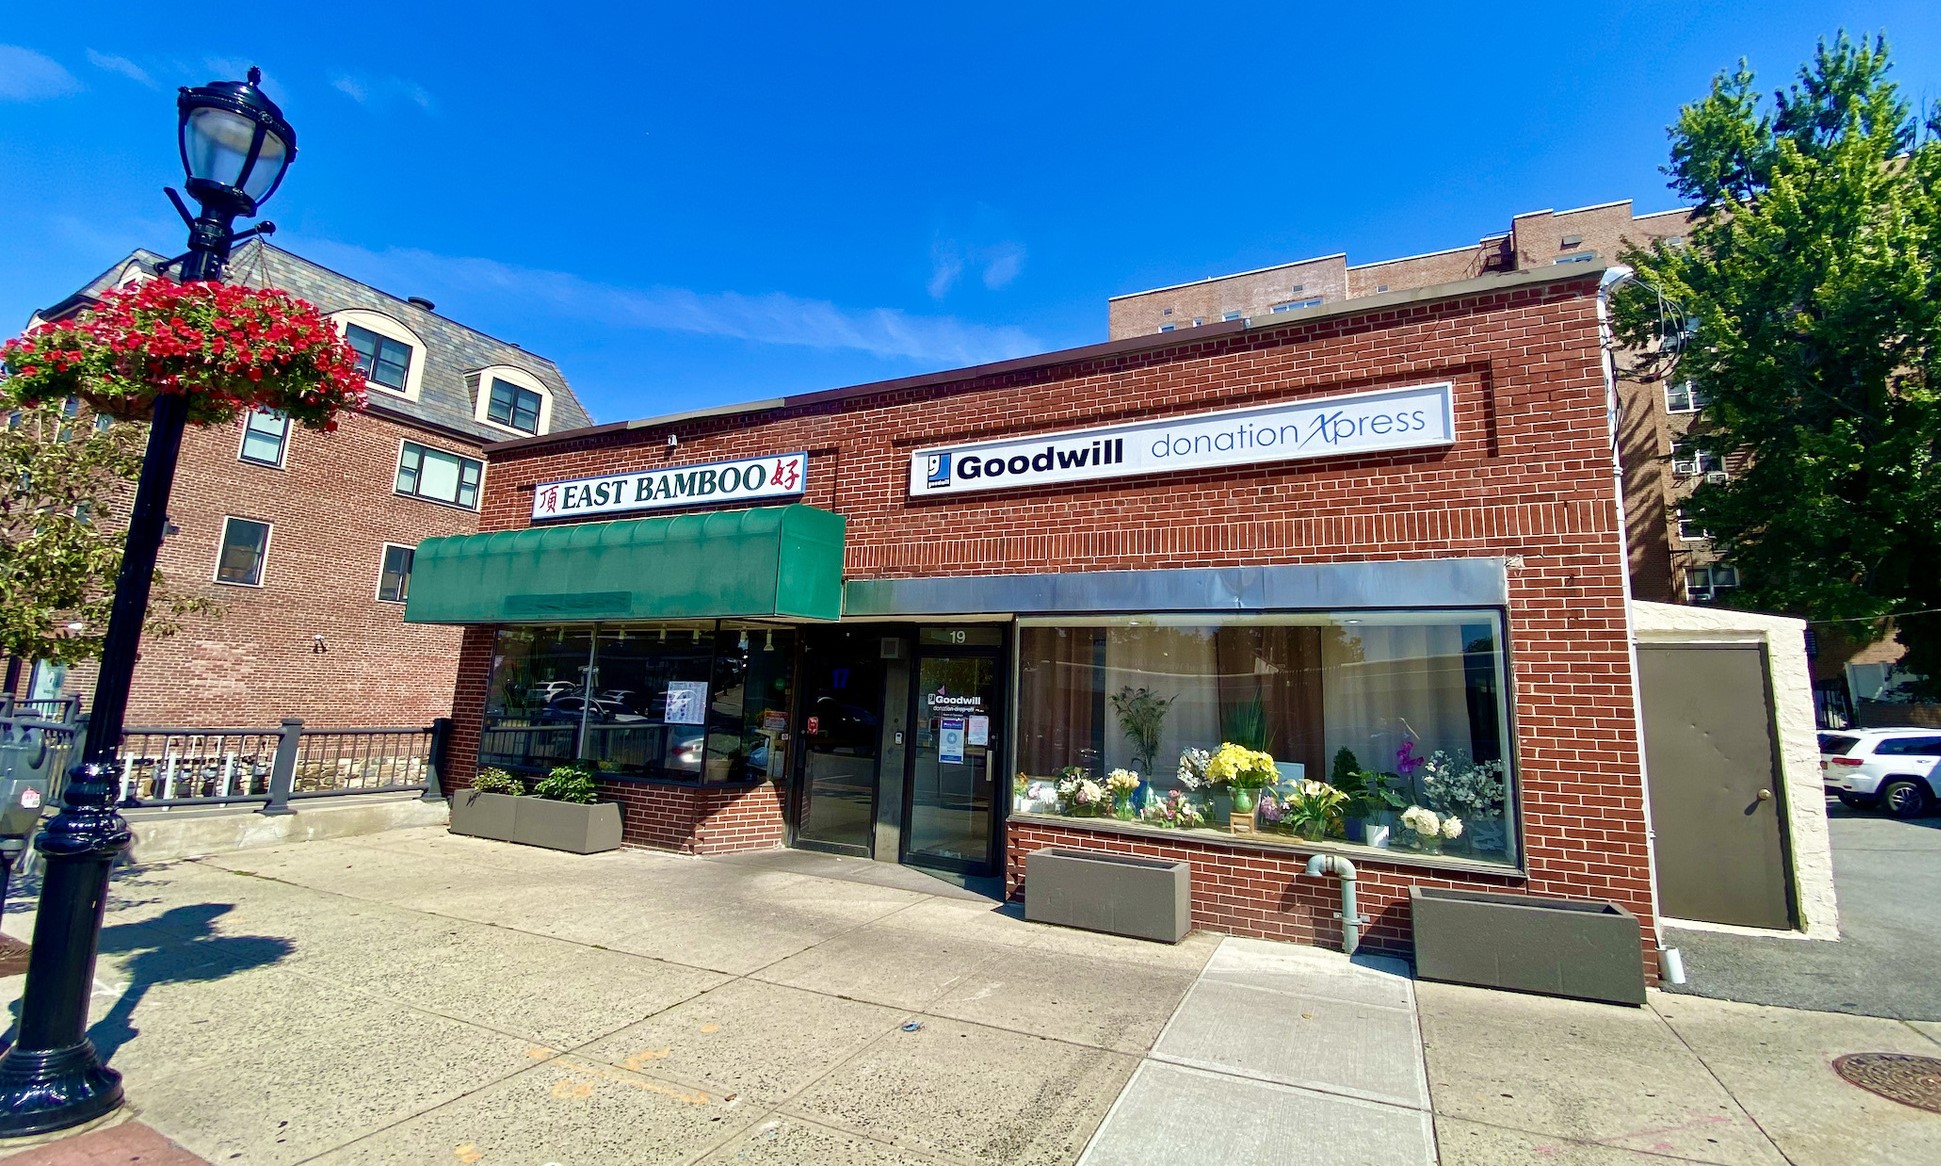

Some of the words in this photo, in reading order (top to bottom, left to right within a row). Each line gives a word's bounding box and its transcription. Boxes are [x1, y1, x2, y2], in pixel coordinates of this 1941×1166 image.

[957, 438, 1123, 480] Goodwill
[1151, 423, 1299, 458] donation
[1298, 410, 1426, 450] Xpress
[561, 479, 628, 510] EAST
[634, 464, 767, 502] BAMBOO
[770, 458, 800, 491] 好
[950, 630, 966, 644] 19
[831, 667, 849, 689] 17
[935, 695, 981, 705] Goodwill
